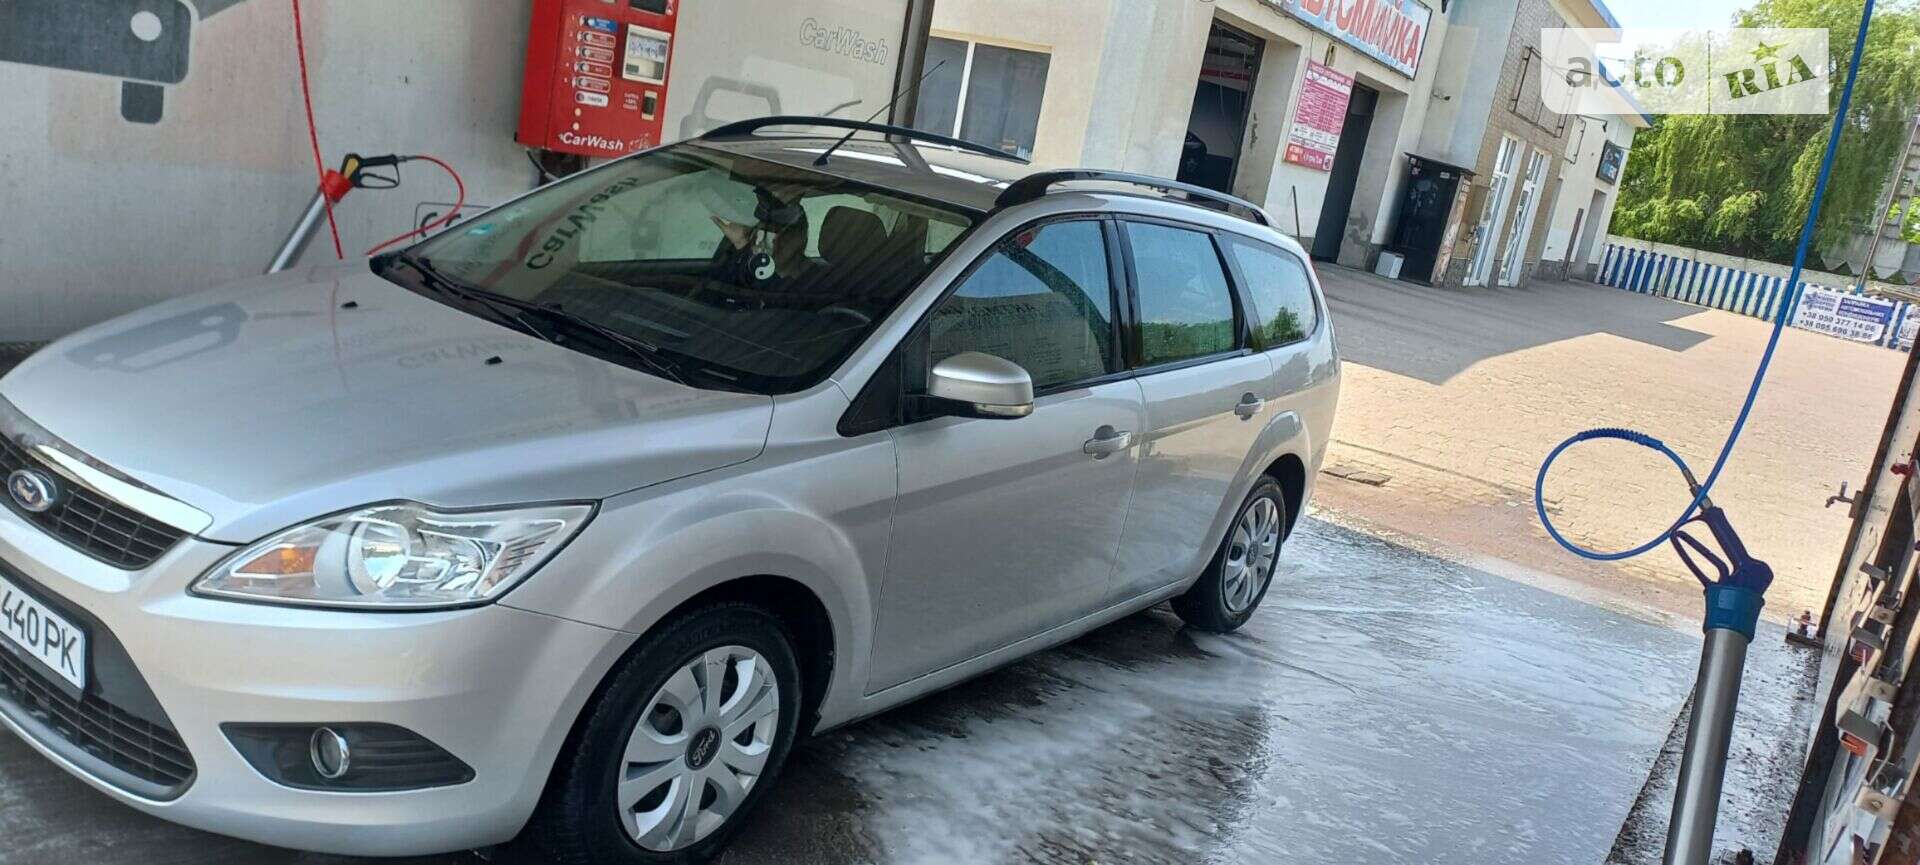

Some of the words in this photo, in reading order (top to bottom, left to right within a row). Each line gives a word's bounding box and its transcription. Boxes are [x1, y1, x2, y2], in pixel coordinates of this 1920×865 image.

[800, 17, 888, 65] CarWash
[1300, 0, 1421, 69] ОМИЙКА
[562, 131, 624, 151] CarWash
[692, 730, 716, 766] Ford
